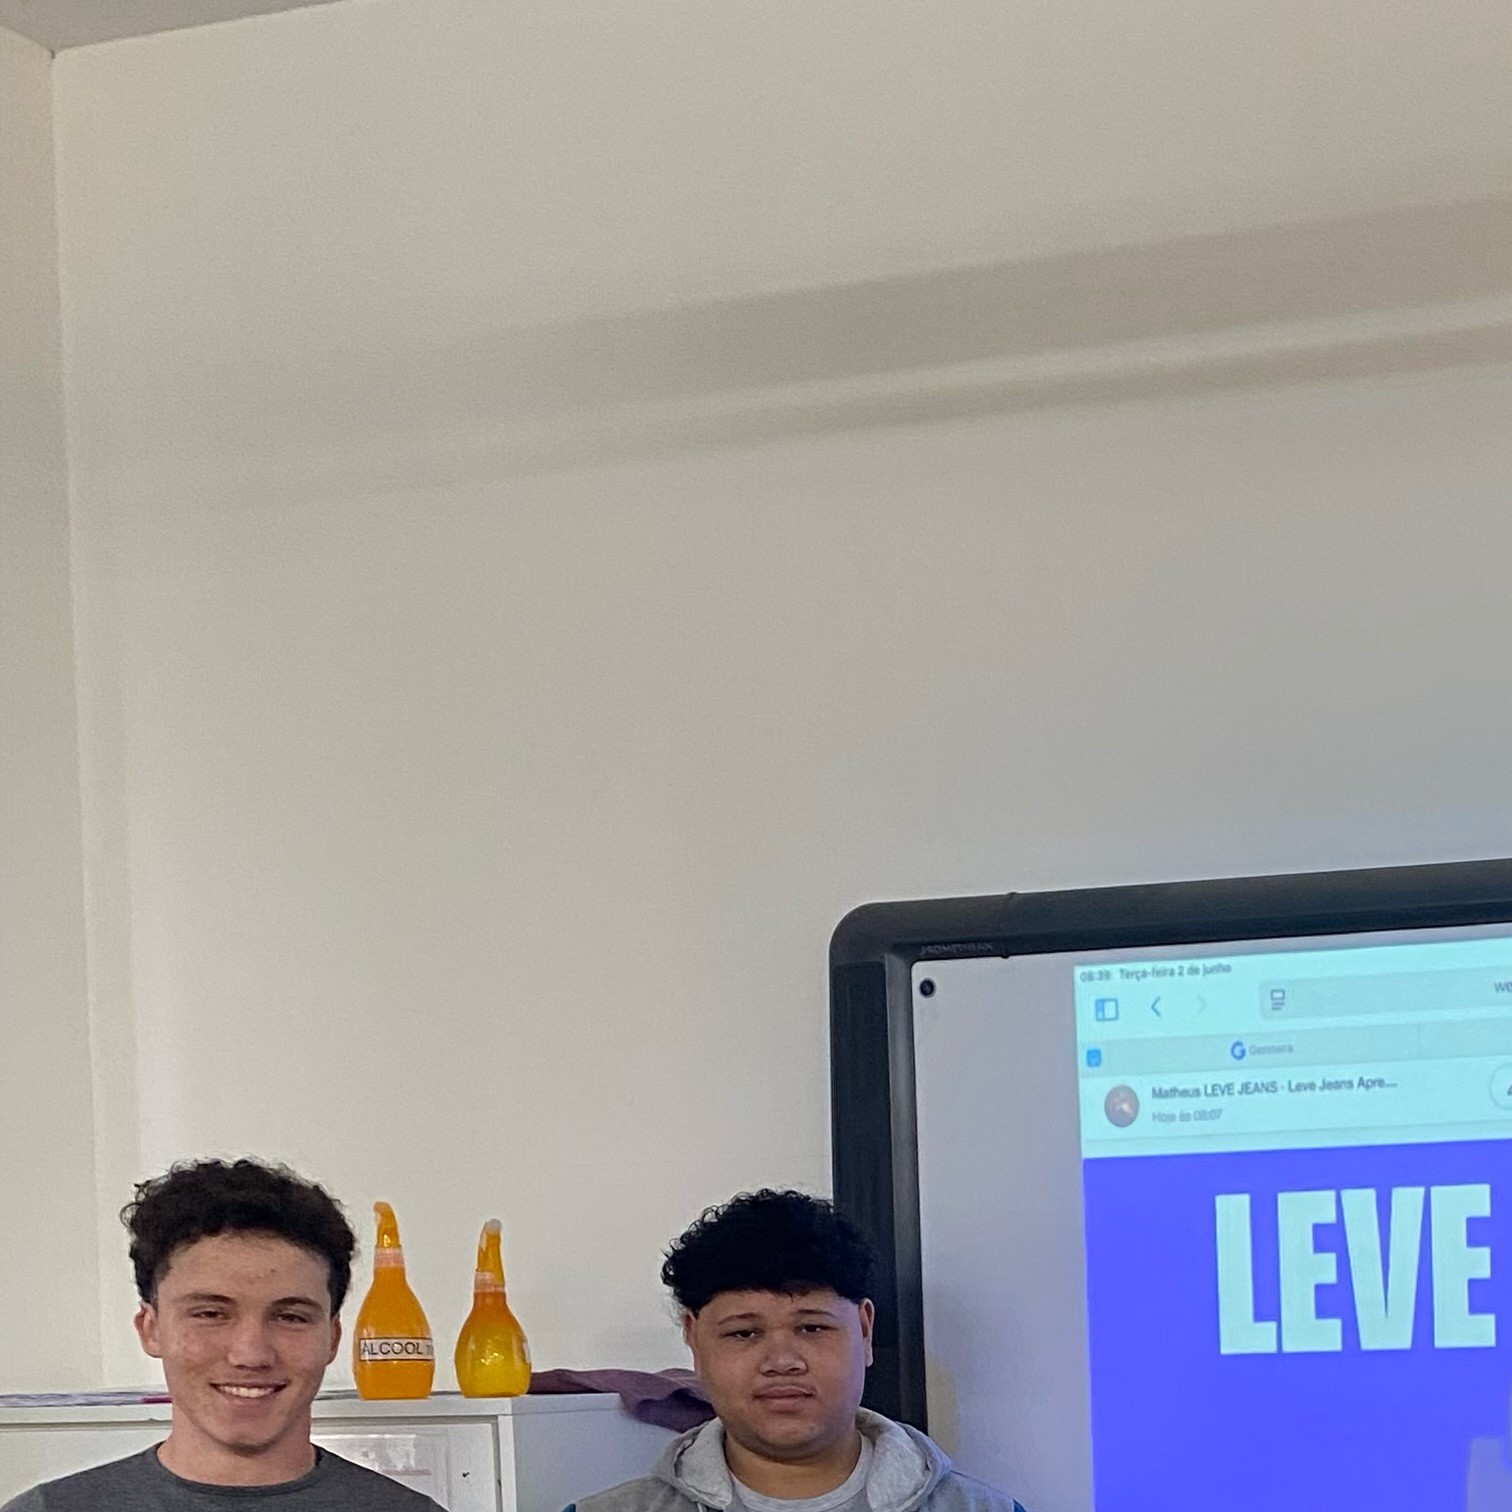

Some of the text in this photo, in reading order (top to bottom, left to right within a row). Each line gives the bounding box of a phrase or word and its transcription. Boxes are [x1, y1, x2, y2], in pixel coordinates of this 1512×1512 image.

[1187, 964, 1200, 976] de
[1201, 963, 1232, 977] junho
[1151, 1085, 1201, 1100] Matheus
[1203, 1083, 1235, 1098] LEVE
[1237, 1081, 1279, 1096] JEANS
[1287, 1079, 1317, 1093] Leve
[1318, 1077, 1355, 1092] Jeans
[1214, 1183, 1497, 1355] LEVE
[362, 1342, 423, 1355] ALCOOL
